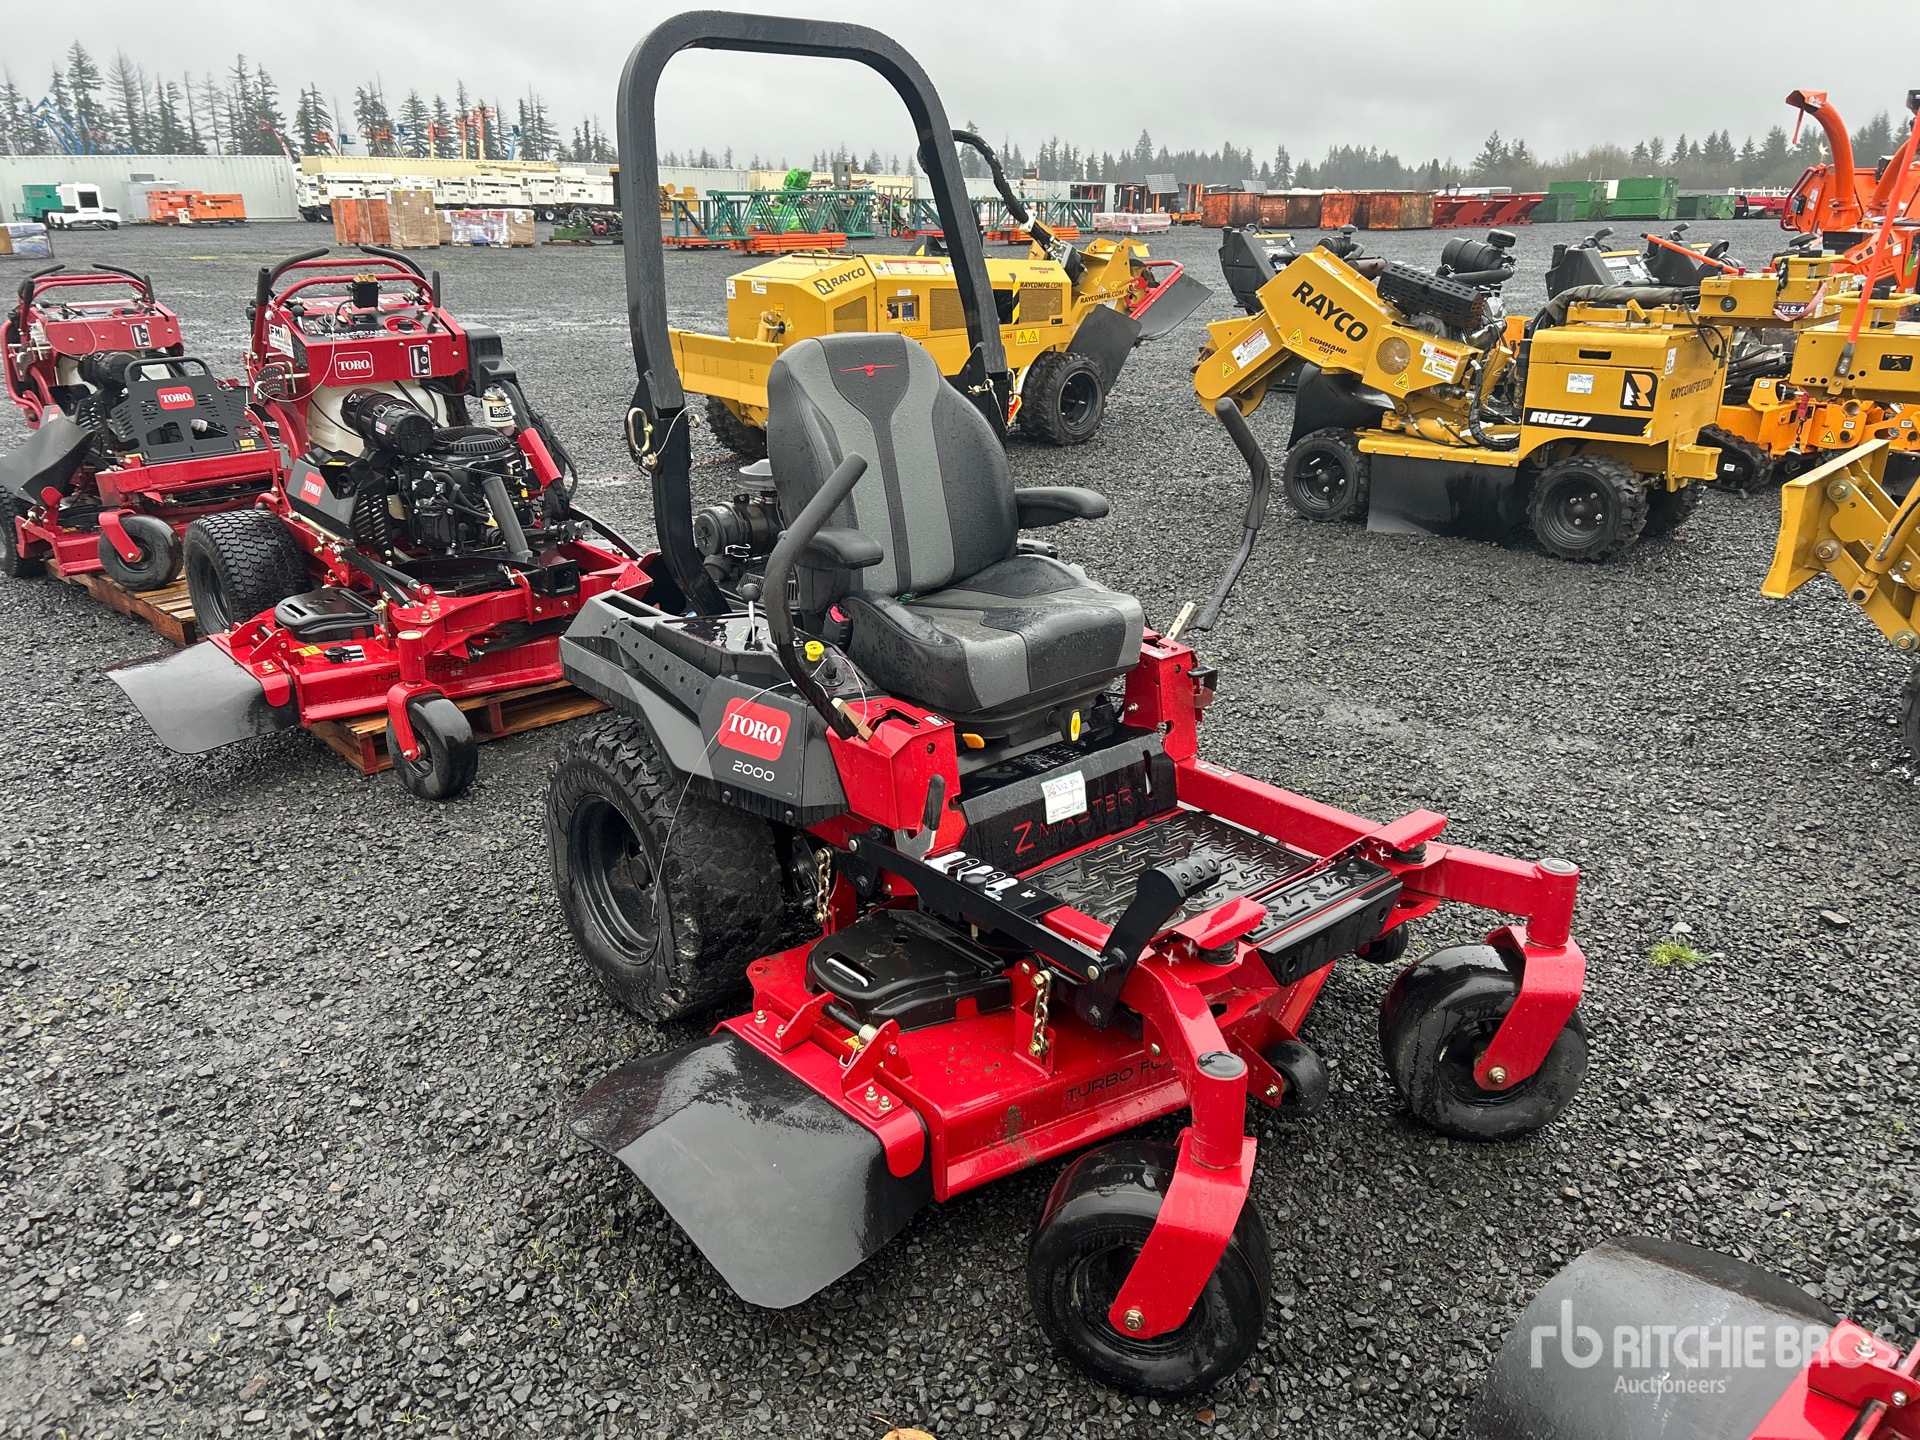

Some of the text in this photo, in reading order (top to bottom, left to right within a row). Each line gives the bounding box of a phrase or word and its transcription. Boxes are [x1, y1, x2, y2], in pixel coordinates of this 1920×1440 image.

[831, 267, 866, 287] RAYCO
[1020, 281, 1063, 289] RAYCOMFG.COM
[1080, 289, 1125, 304] RAYCOMFG.COM
[1291, 280, 1369, 342] RAYCO
[1308, 336, 1348, 355] COMMAND
[1318, 345, 1334, 355] CUT
[337, 359, 370, 371] TORO
[160, 392, 193, 404] TORO
[1669, 377, 1714, 401] RAYCOMFG.COM
[1529, 411, 1592, 428] RG27
[303, 480, 321, 497] TORO
[373, 660, 470, 683] TUR FORCE
[728, 712, 781, 745] TORO
[732, 759, 775, 782] 2000
[1013, 820, 1037, 854] Z
[1066, 1067, 1134, 1101] TURBO
